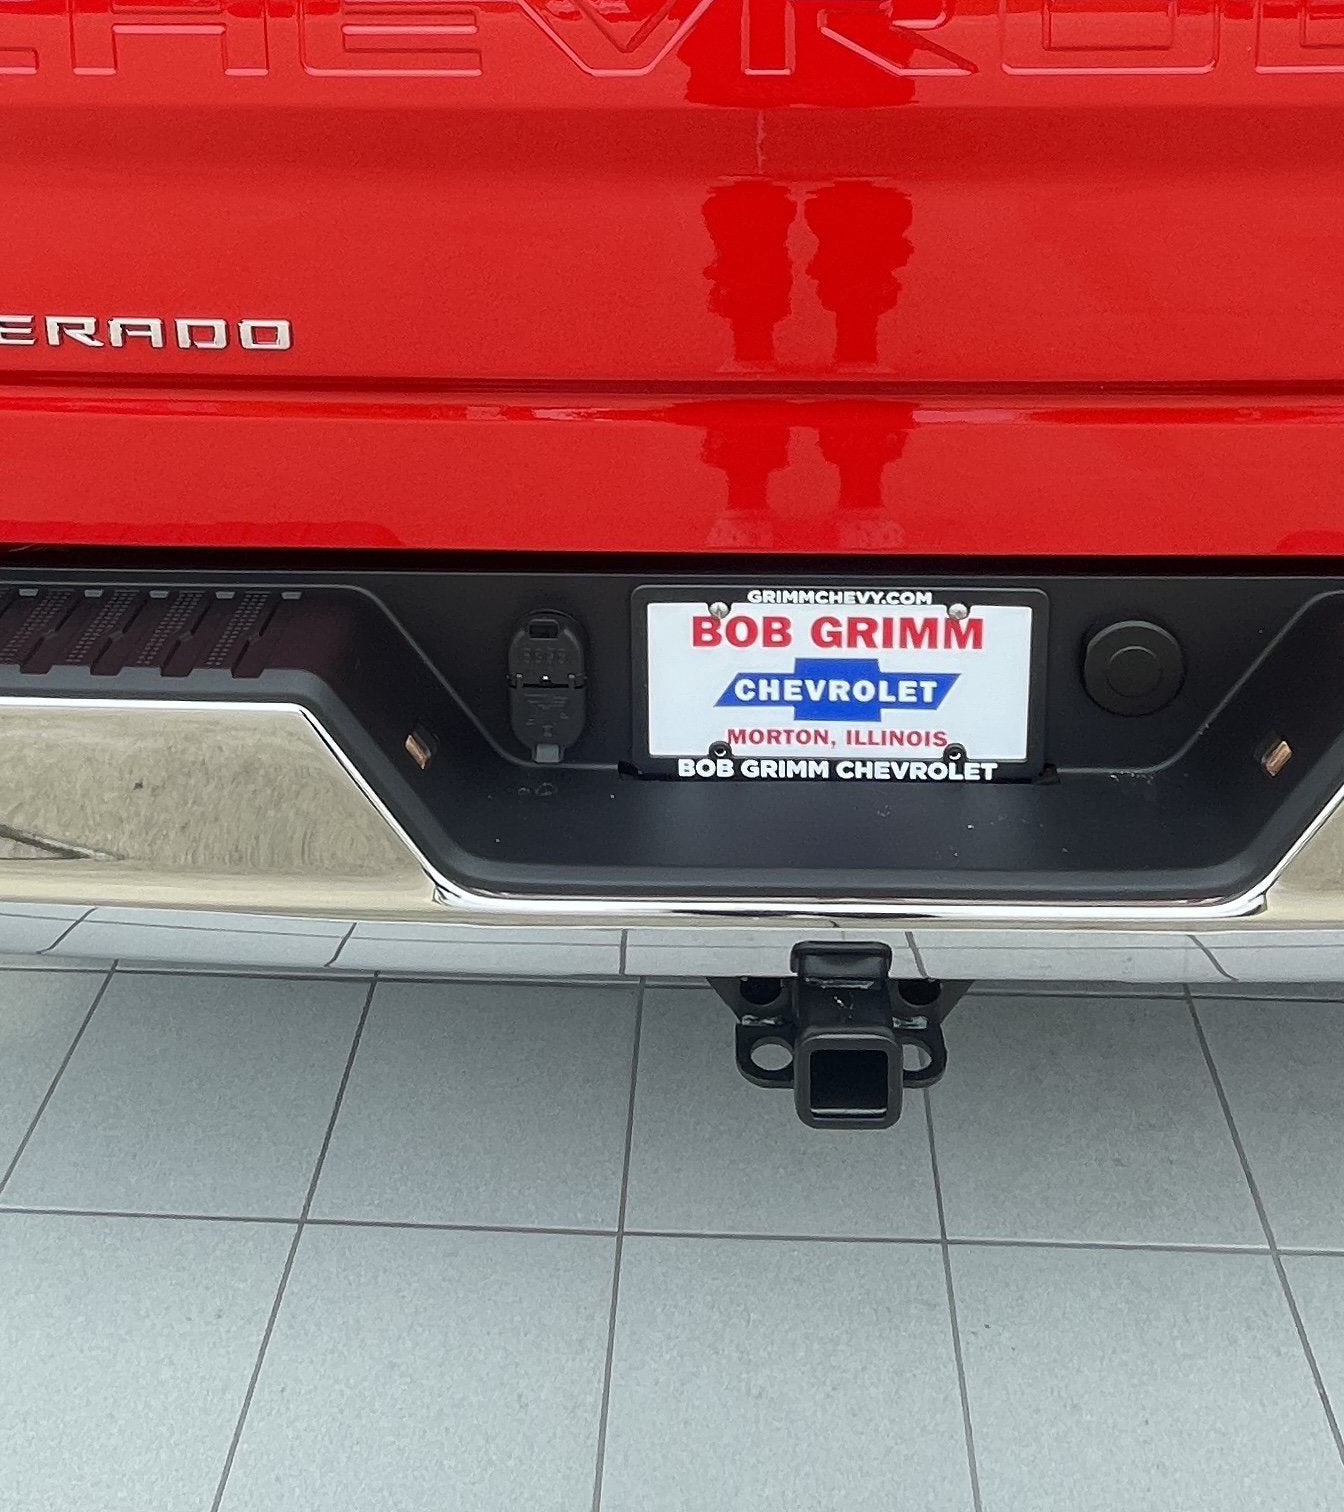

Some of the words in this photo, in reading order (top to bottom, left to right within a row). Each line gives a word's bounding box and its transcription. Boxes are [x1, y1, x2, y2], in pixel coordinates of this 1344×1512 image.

[747, 590, 932, 605] GRIMMCHEVY.COM
[692, 616, 792, 648] BOB
[810, 616, 984, 649] GRIMM
[734, 679, 938, 703] CHEVROLET
[727, 728, 836, 748] MORTON,
[846, 730, 948, 747] ILLINOIS
[678, 759, 735, 778] BOB
[741, 759, 829, 779] GRIMM
[836, 761, 998, 781] CHEVROLET
